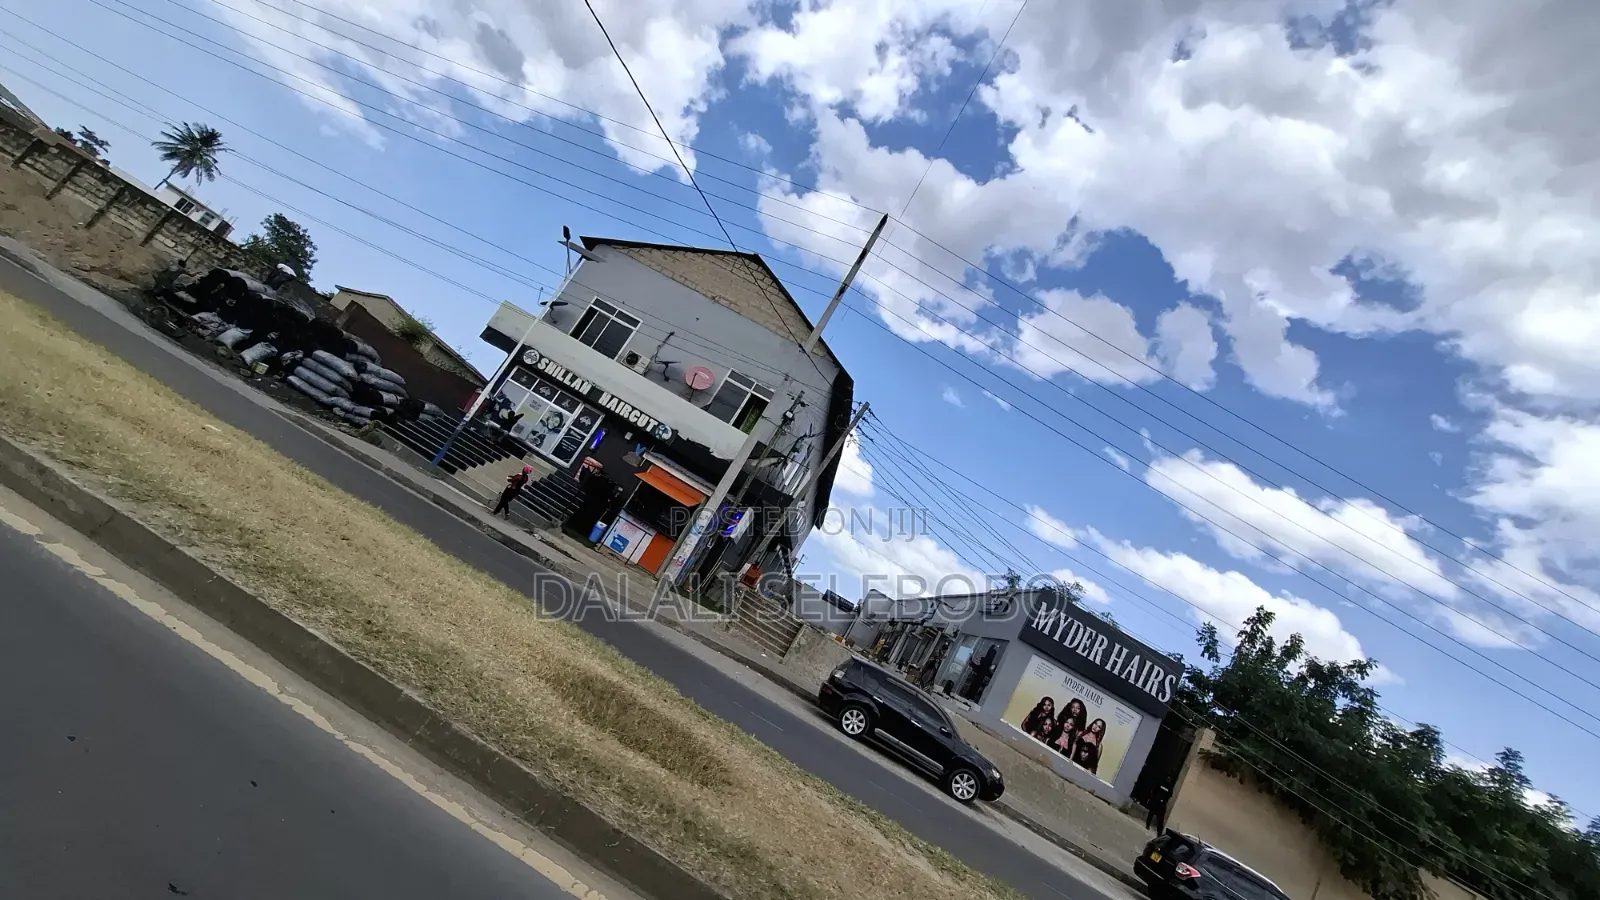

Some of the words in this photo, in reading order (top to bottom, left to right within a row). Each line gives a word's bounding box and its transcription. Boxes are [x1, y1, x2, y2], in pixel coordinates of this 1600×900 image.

[537, 357, 592, 395] SHILLAH
[598, 391, 658, 432] HAIRCUT
[1031, 601, 1108, 665] MYDER
[1105, 642, 1176, 703] HAIRS
[1062, 675, 1084, 698] MYDER
[1083, 686, 1105, 706] HAIRS
